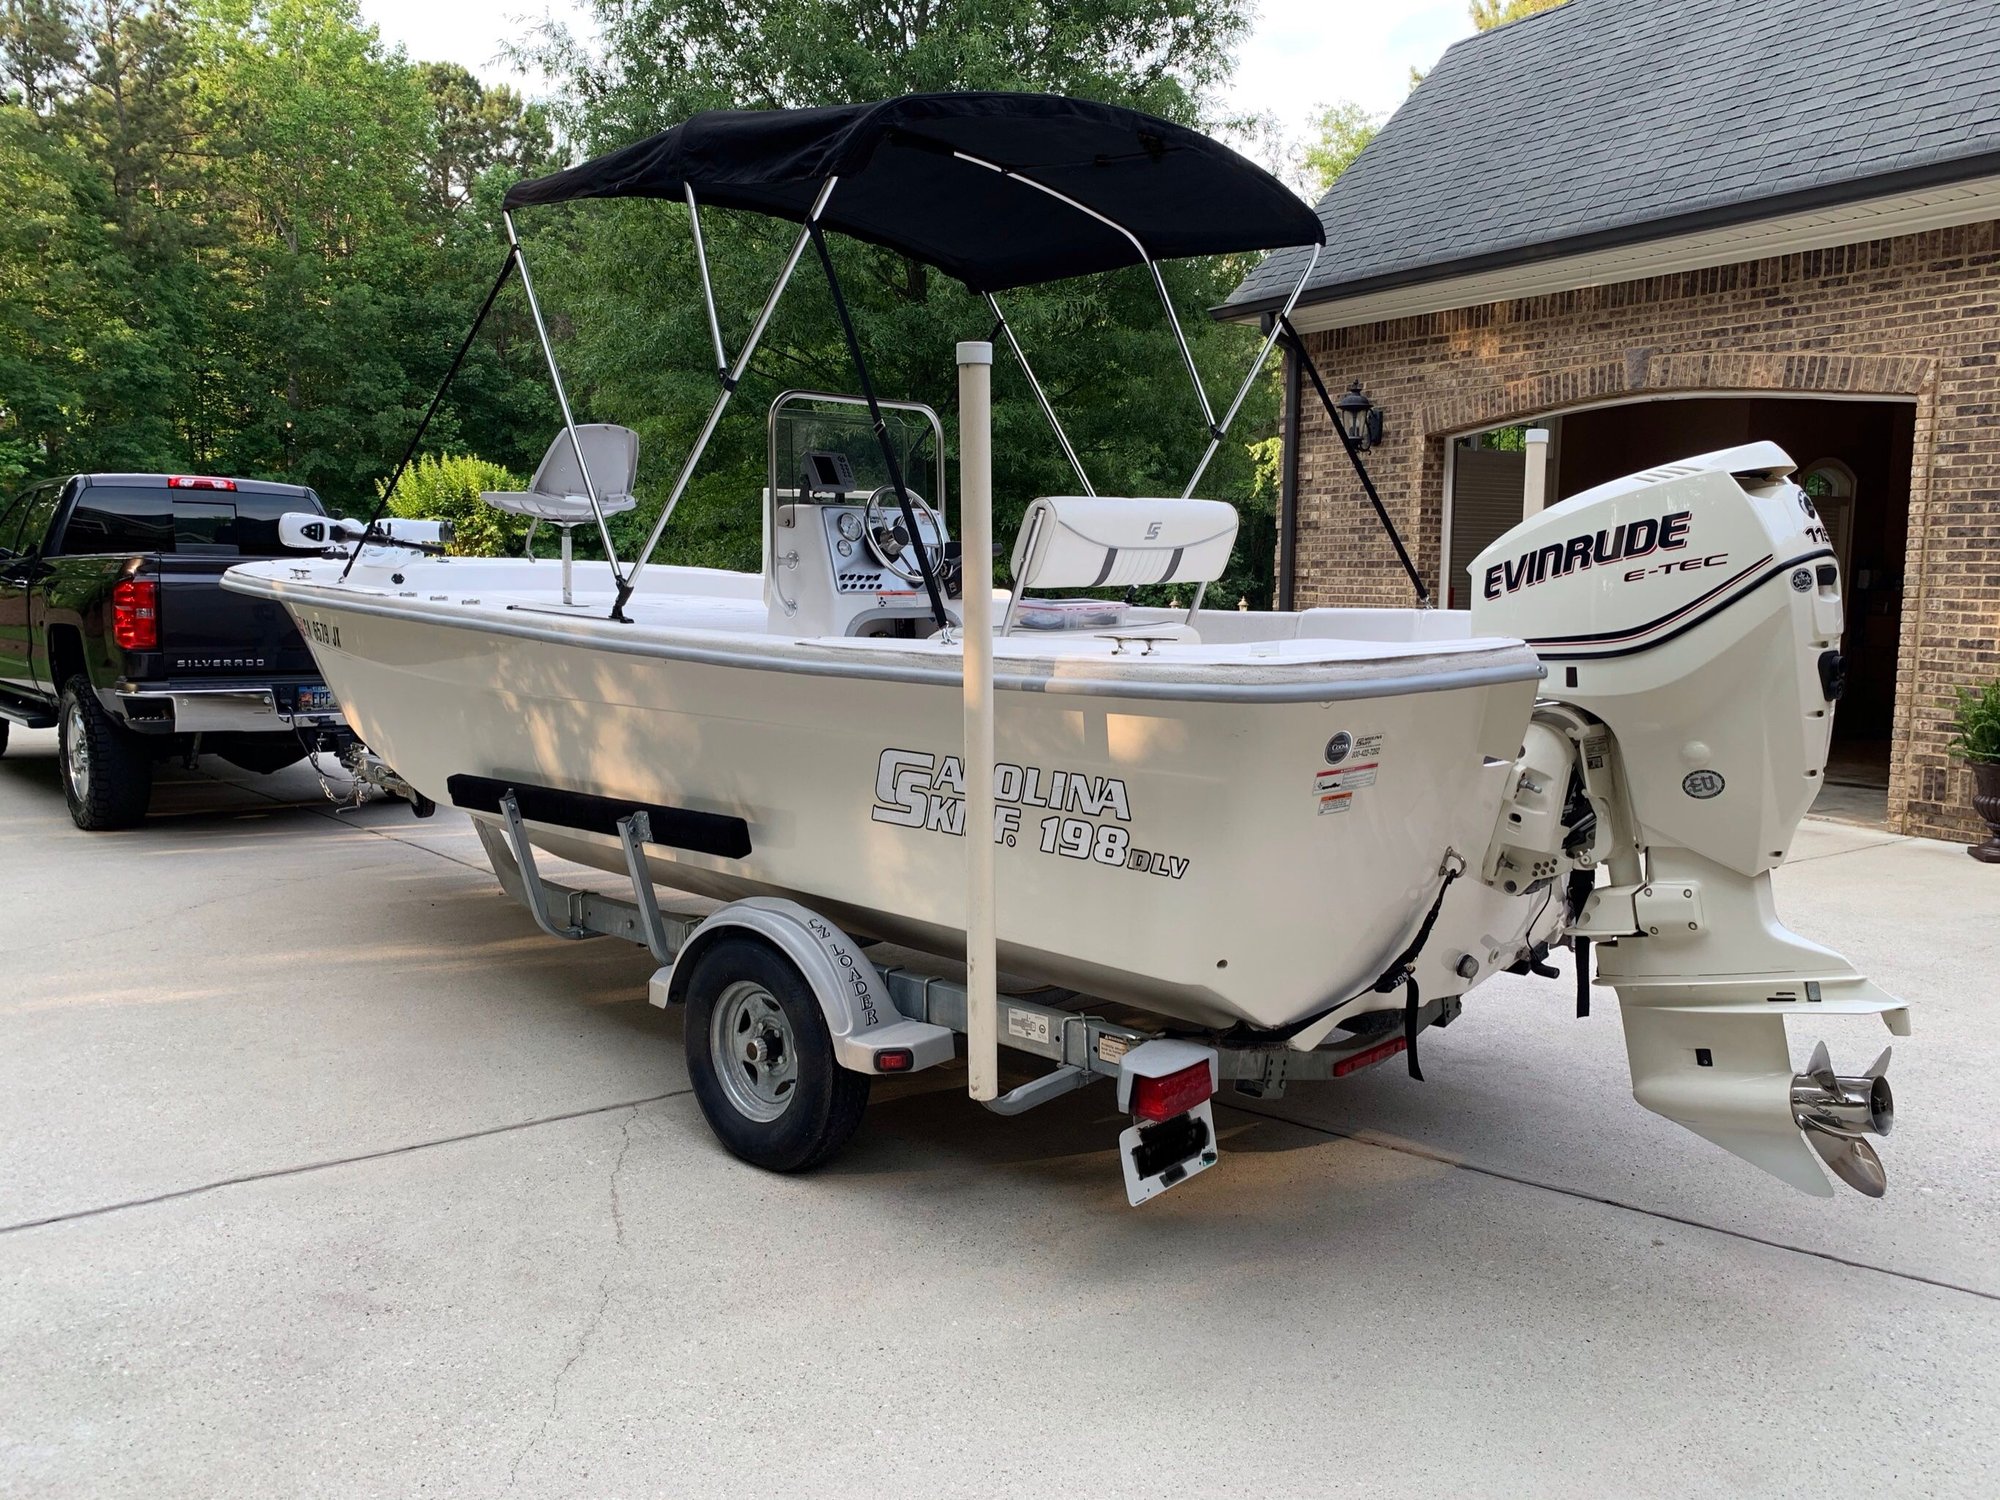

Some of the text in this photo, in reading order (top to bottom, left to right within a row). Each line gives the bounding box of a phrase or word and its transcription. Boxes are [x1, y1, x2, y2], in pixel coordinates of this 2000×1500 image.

[1484, 510, 1693, 601] EVINRUDE
[1623, 553, 1729, 582] E-TEC
[176, 658, 265, 668] SILVERADO
[875, 748, 1132, 821] CAOLINA
[872, 770, 1190, 879] SKIF 198 DLV
[830, 943, 879, 1027] LOADER
